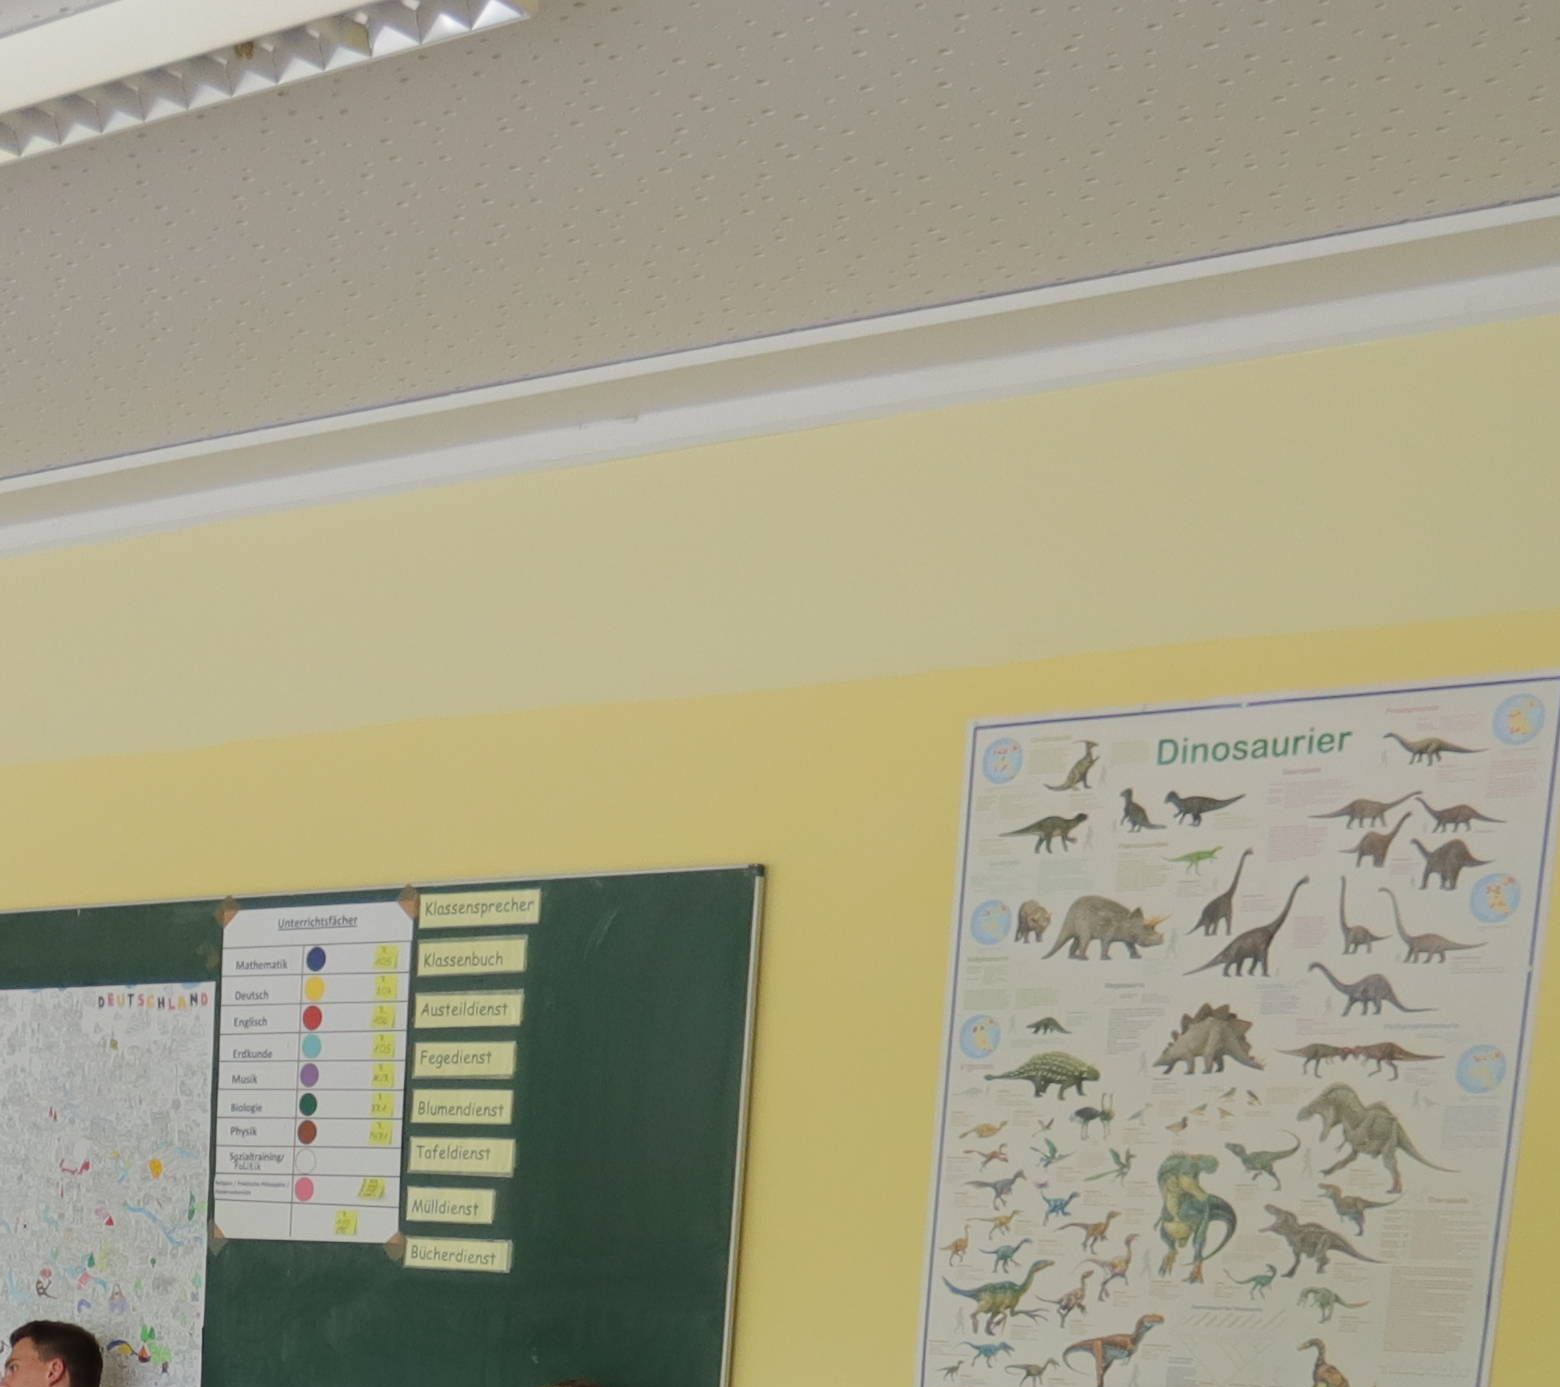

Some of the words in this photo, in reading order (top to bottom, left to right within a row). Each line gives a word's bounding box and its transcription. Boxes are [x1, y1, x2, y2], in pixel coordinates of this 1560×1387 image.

[1156, 728, 1353, 766] Dinosaurier
[425, 896, 535, 918] Klassensprecher
[278, 915, 359, 931] Unterrichtsfächer
[235, 959, 289, 971] Mathematik
[423, 951, 504, 968] Klassenbuch
[97, 992, 209, 1010] DEUTSCHLAND
[234, 990, 270, 1001] Deutsch
[420, 1002, 508, 1017] Austeildienst
[233, 1016, 268, 1029] Englisch
[232, 1048, 273, 1060] Erdkunde
[419, 1048, 492, 1069] Fegedienst
[231, 1073, 258, 1085] Musik
[230, 1102, 263, 1114] Biologie
[417, 1100, 504, 1117] Blumendienst
[230, 1125, 258, 1138] Physik
[416, 1144, 491, 1161] Tafeldienst
[411, 1199, 480, 1217] Mülldienst
[411, 1244, 497, 1266] Bücherdienst
